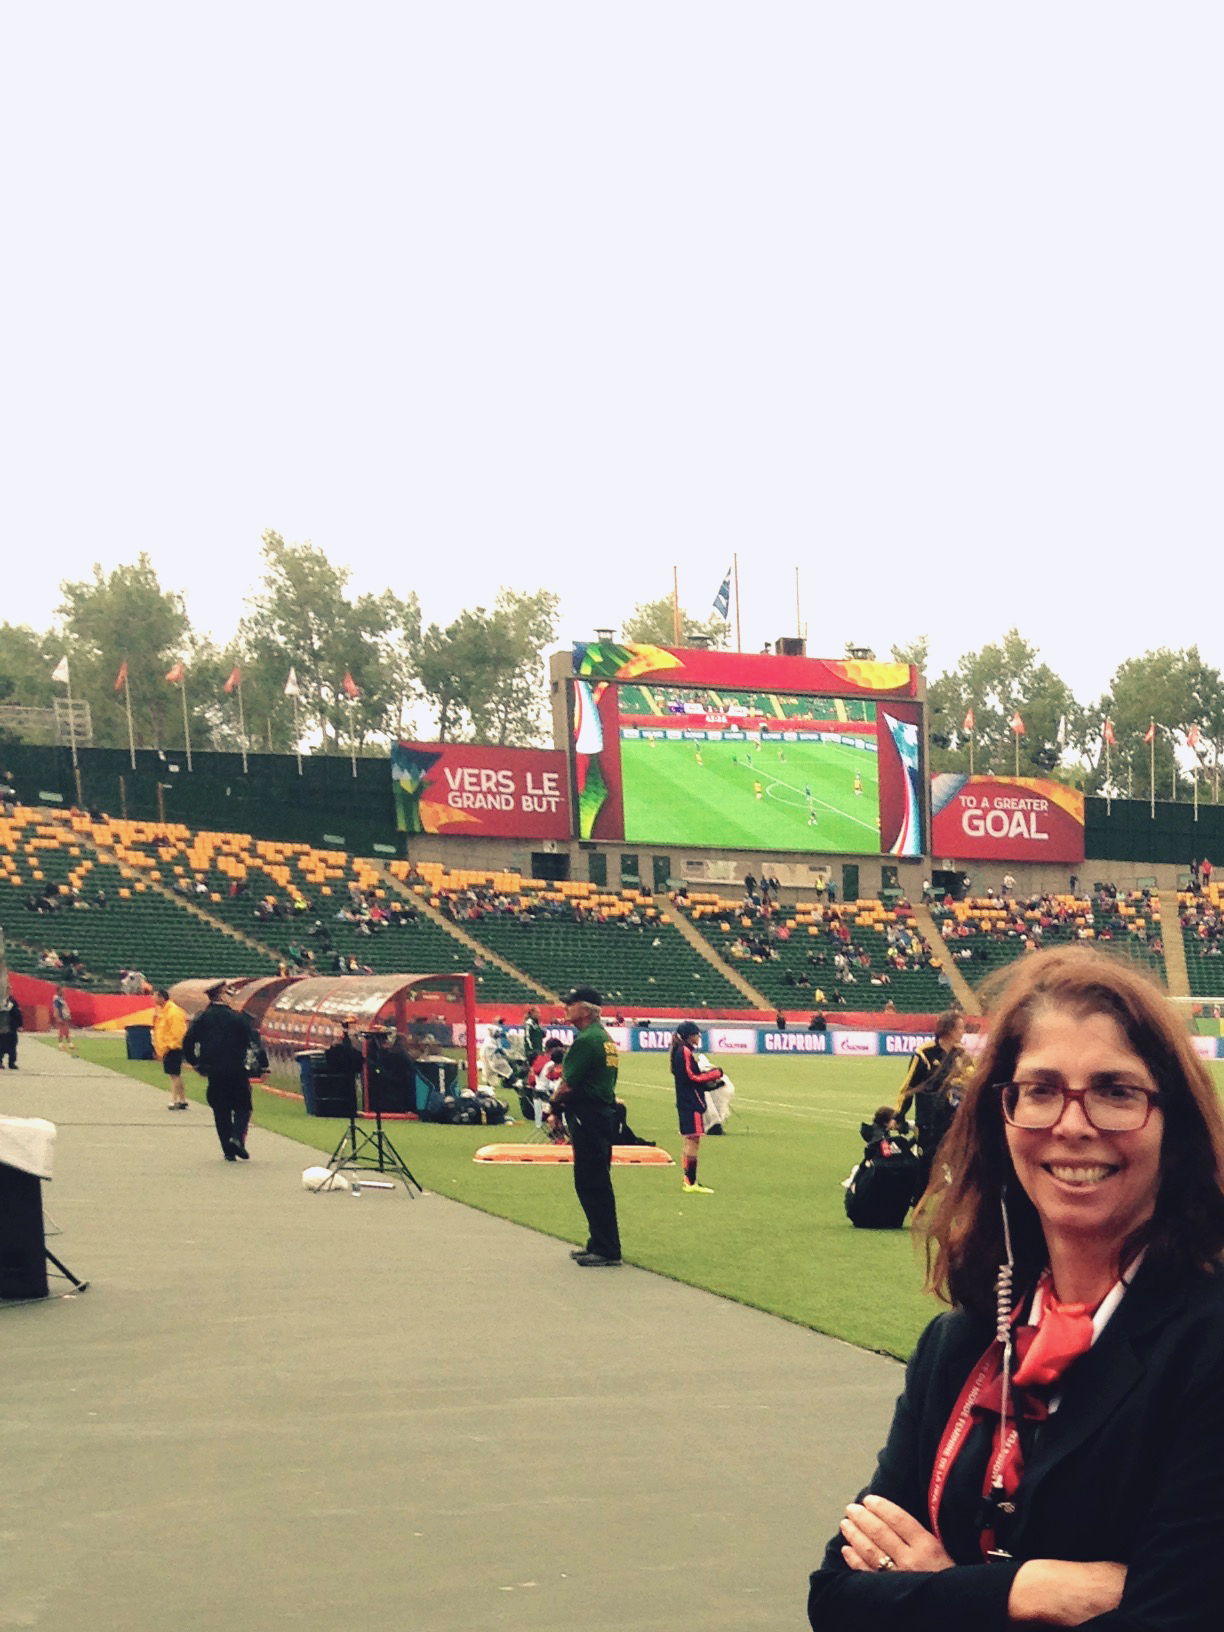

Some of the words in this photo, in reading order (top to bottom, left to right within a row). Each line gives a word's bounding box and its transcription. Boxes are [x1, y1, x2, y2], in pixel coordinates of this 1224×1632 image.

[443, 767, 516, 794] VERS
[525, 772, 561, 796] LE
[447, 791, 515, 811] GRAND
[521, 797, 562, 814] BUT
[959, 795, 977, 808] TO
[981, 798, 990, 808] A
[994, 798, 1049, 811] GREATER
[961, 808, 1049, 840] GOAL
[765, 1033, 826, 1051] GAZPROM
